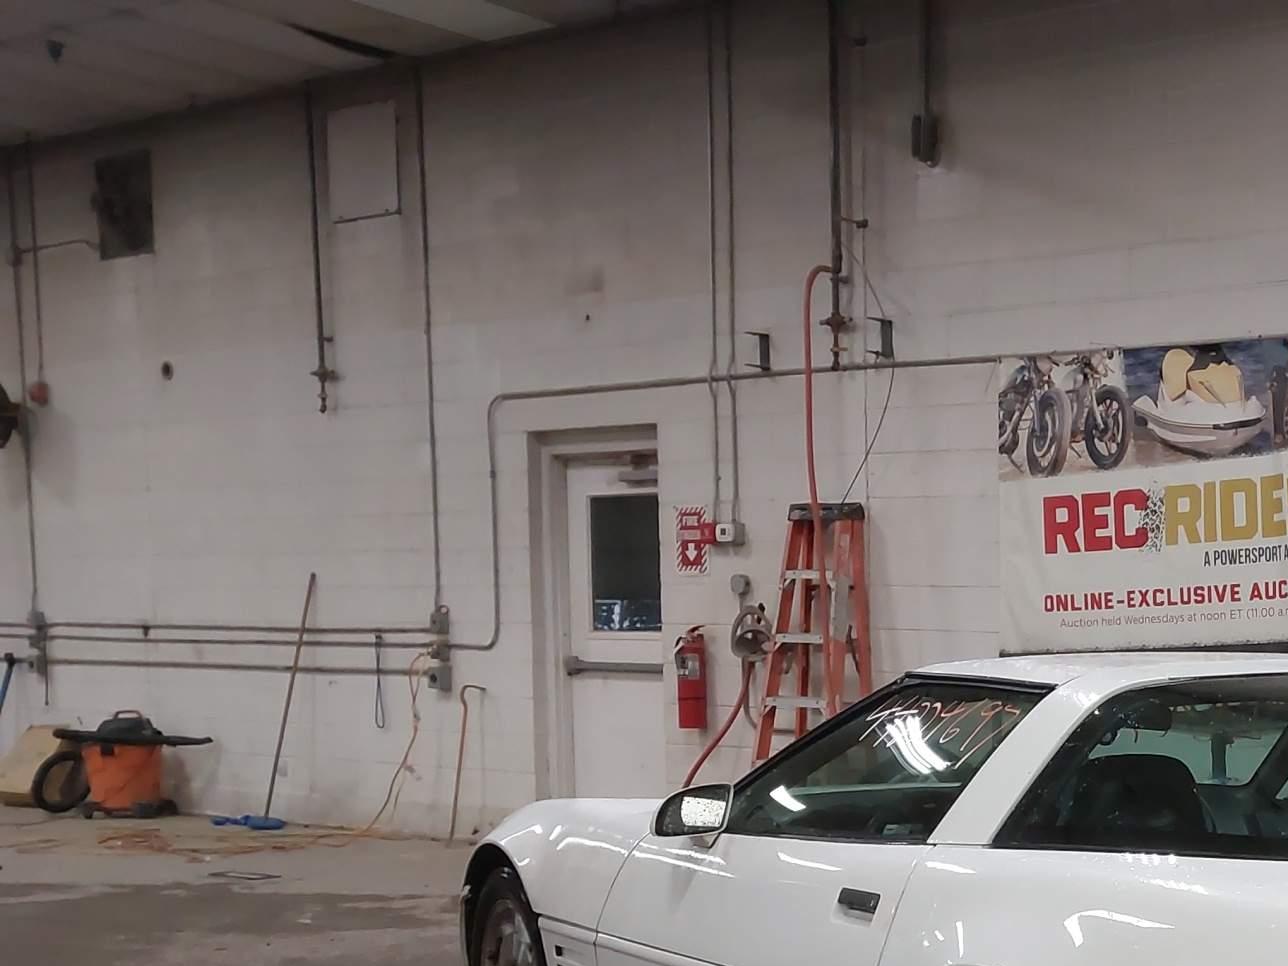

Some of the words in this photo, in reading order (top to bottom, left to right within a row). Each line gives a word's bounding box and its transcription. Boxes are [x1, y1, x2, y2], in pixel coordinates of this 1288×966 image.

[1043, 487, 1150, 555] REC
[1203, 551, 1211, 567] A
[1213, 545, 1282, 566] POWERSPORT
[1043, 583, 1241, 613] ONLINE-EXCLUSIVE
[1060, 618, 1099, 628] Auction
[1101, 616, 1122, 626] held
[1124, 613, 1185, 625] Wednesdays
[1187, 613, 1197, 622] at
[1199, 611, 1226, 621] noon
[1229, 608, 1243, 620] ET
